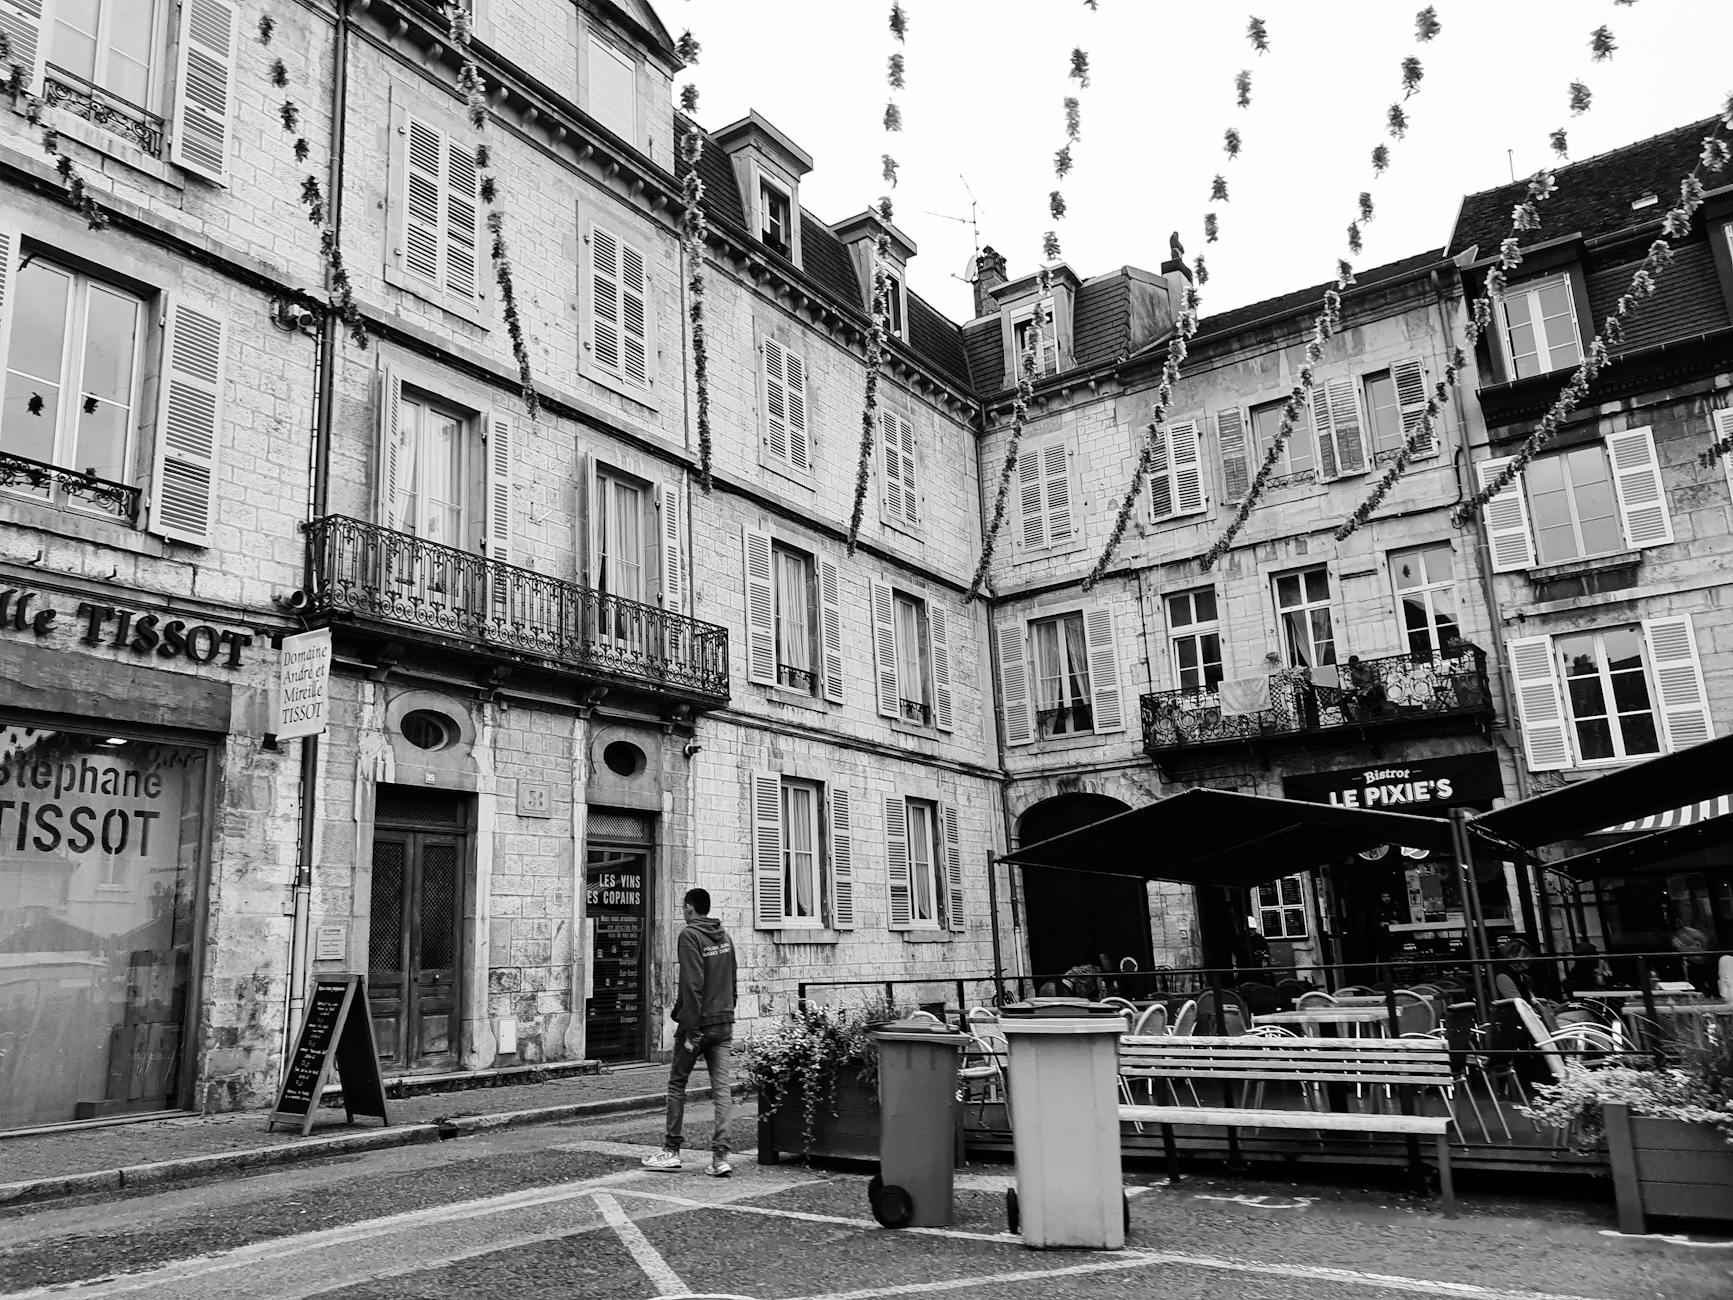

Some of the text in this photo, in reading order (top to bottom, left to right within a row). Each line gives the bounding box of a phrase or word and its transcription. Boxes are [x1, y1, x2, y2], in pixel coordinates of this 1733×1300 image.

[77, 602, 252, 667] TISSOT
[284, 645, 327, 666] Domaine
[315, 665, 325, 678] et
[282, 702, 323, 724] TISSOT
[1363, 769, 1411, 784] Bistrot
[1329, 778, 1453, 808] LE PIXIE'S
[599, 873, 641, 889] LES VINS
[603, 890, 641, 905] COPAINS
